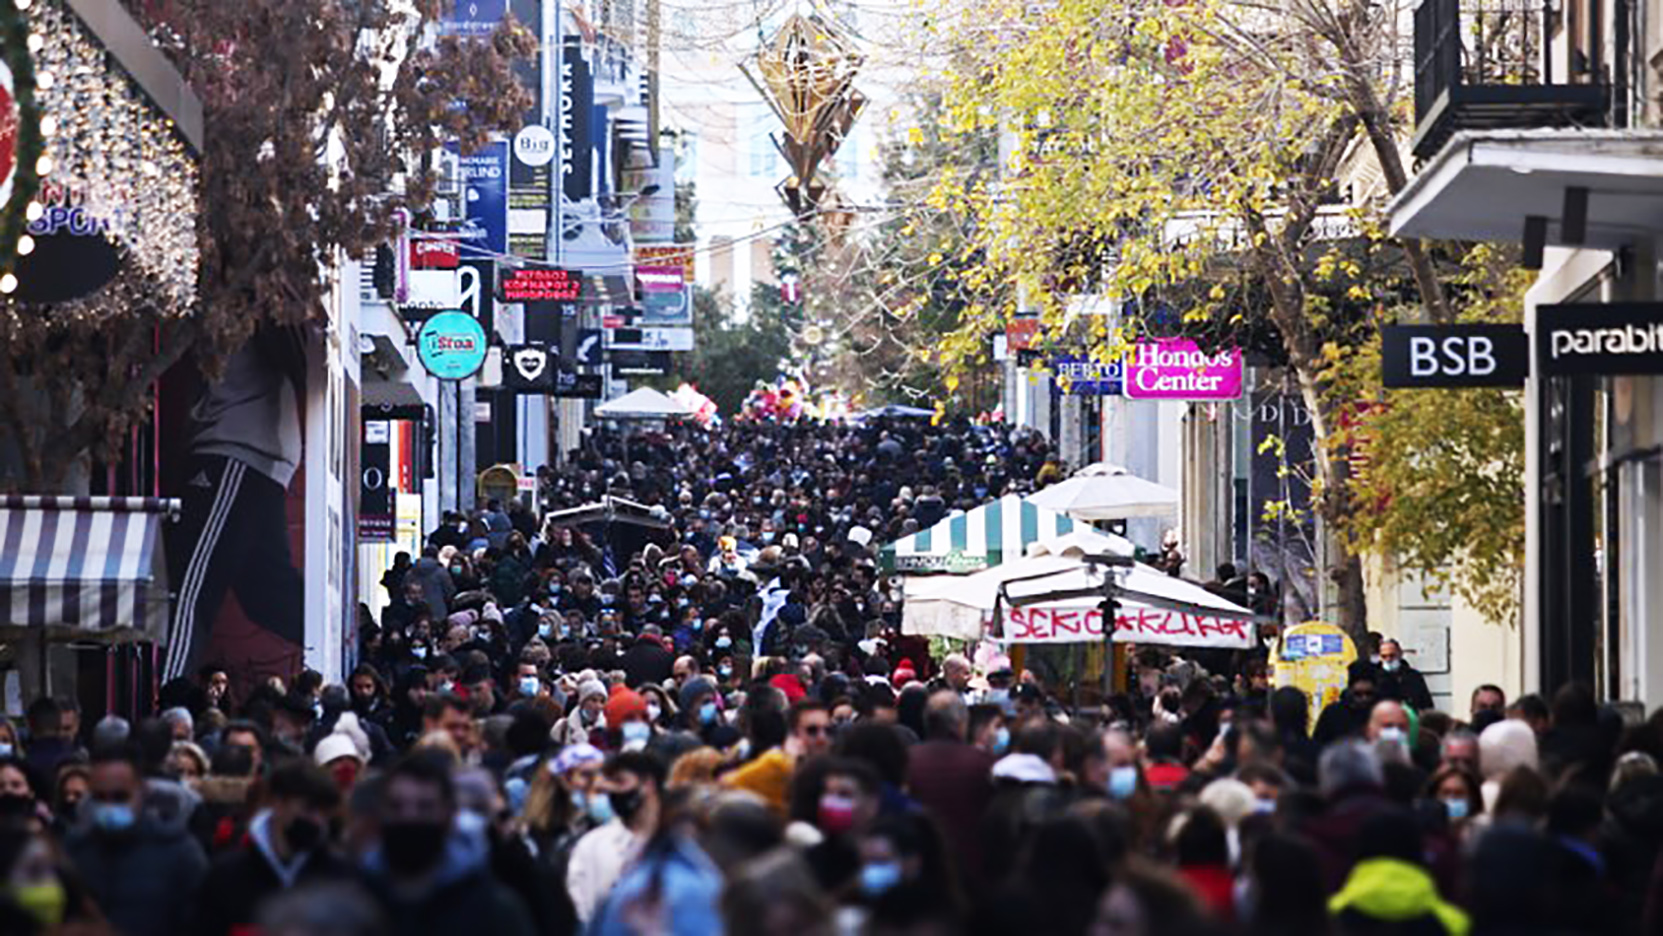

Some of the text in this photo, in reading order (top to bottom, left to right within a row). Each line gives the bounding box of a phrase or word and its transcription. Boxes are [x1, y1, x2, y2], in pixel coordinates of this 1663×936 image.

[1136, 343, 1233, 368] Hondos
[1410, 337, 1496, 376] BSB
[1136, 366, 1222, 391] Center
